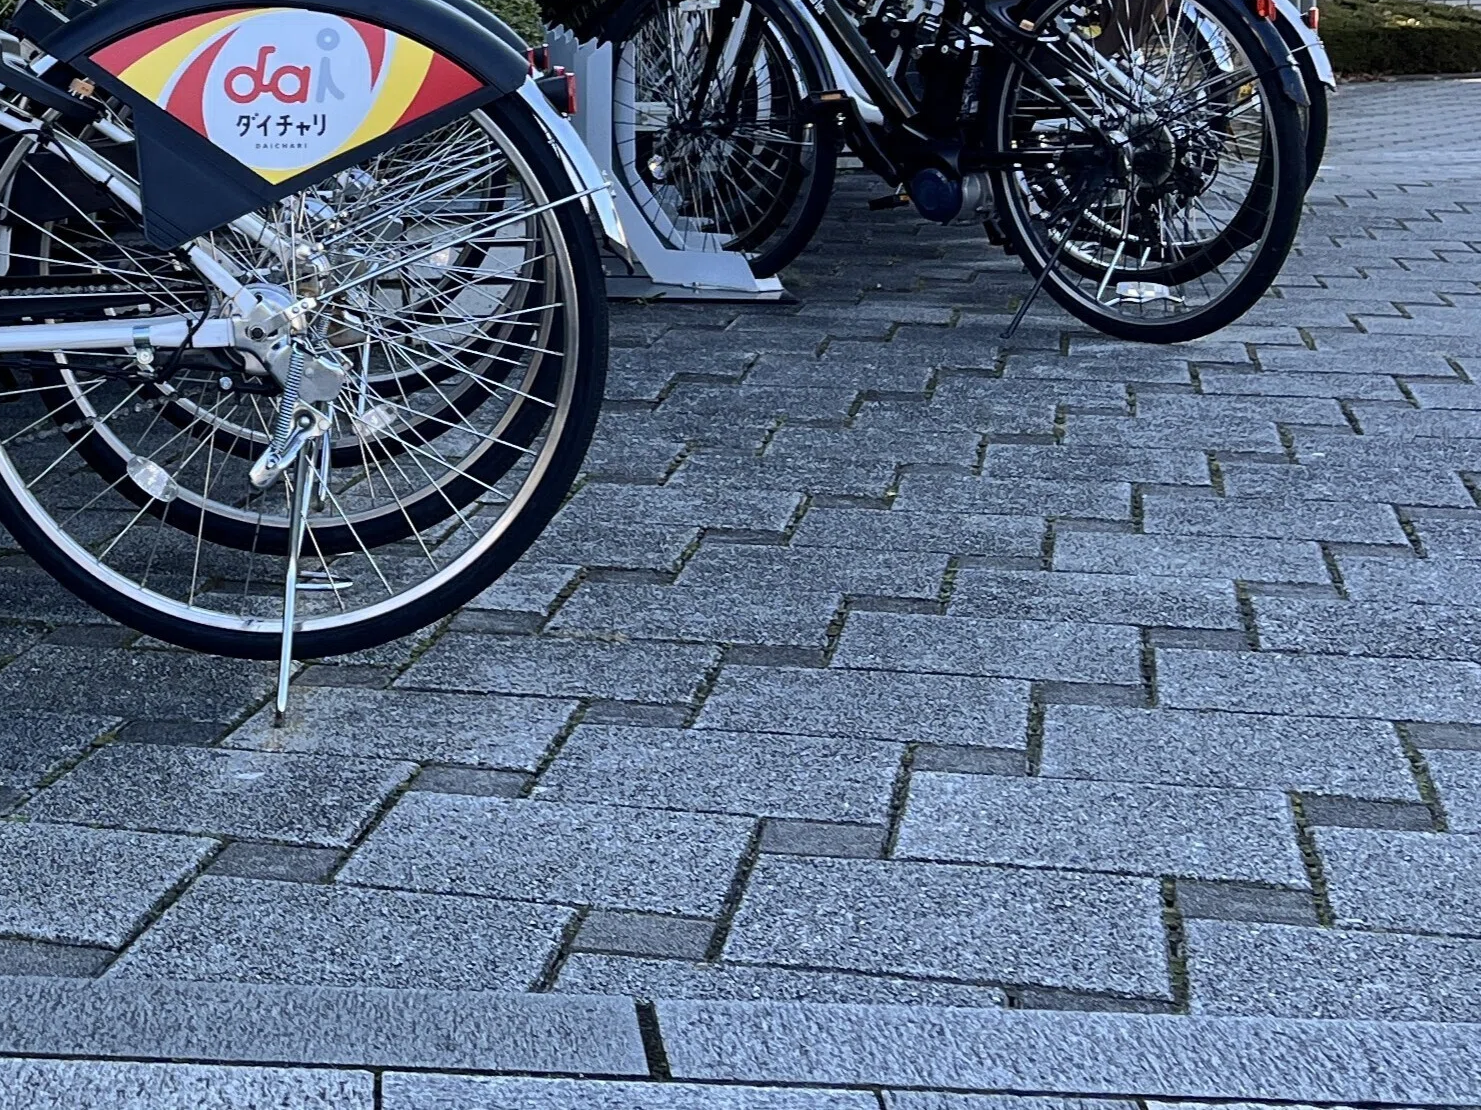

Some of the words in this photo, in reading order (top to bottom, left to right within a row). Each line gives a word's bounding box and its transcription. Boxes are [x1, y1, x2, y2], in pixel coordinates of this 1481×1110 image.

[236, 112, 327, 137] ダイチャリ
